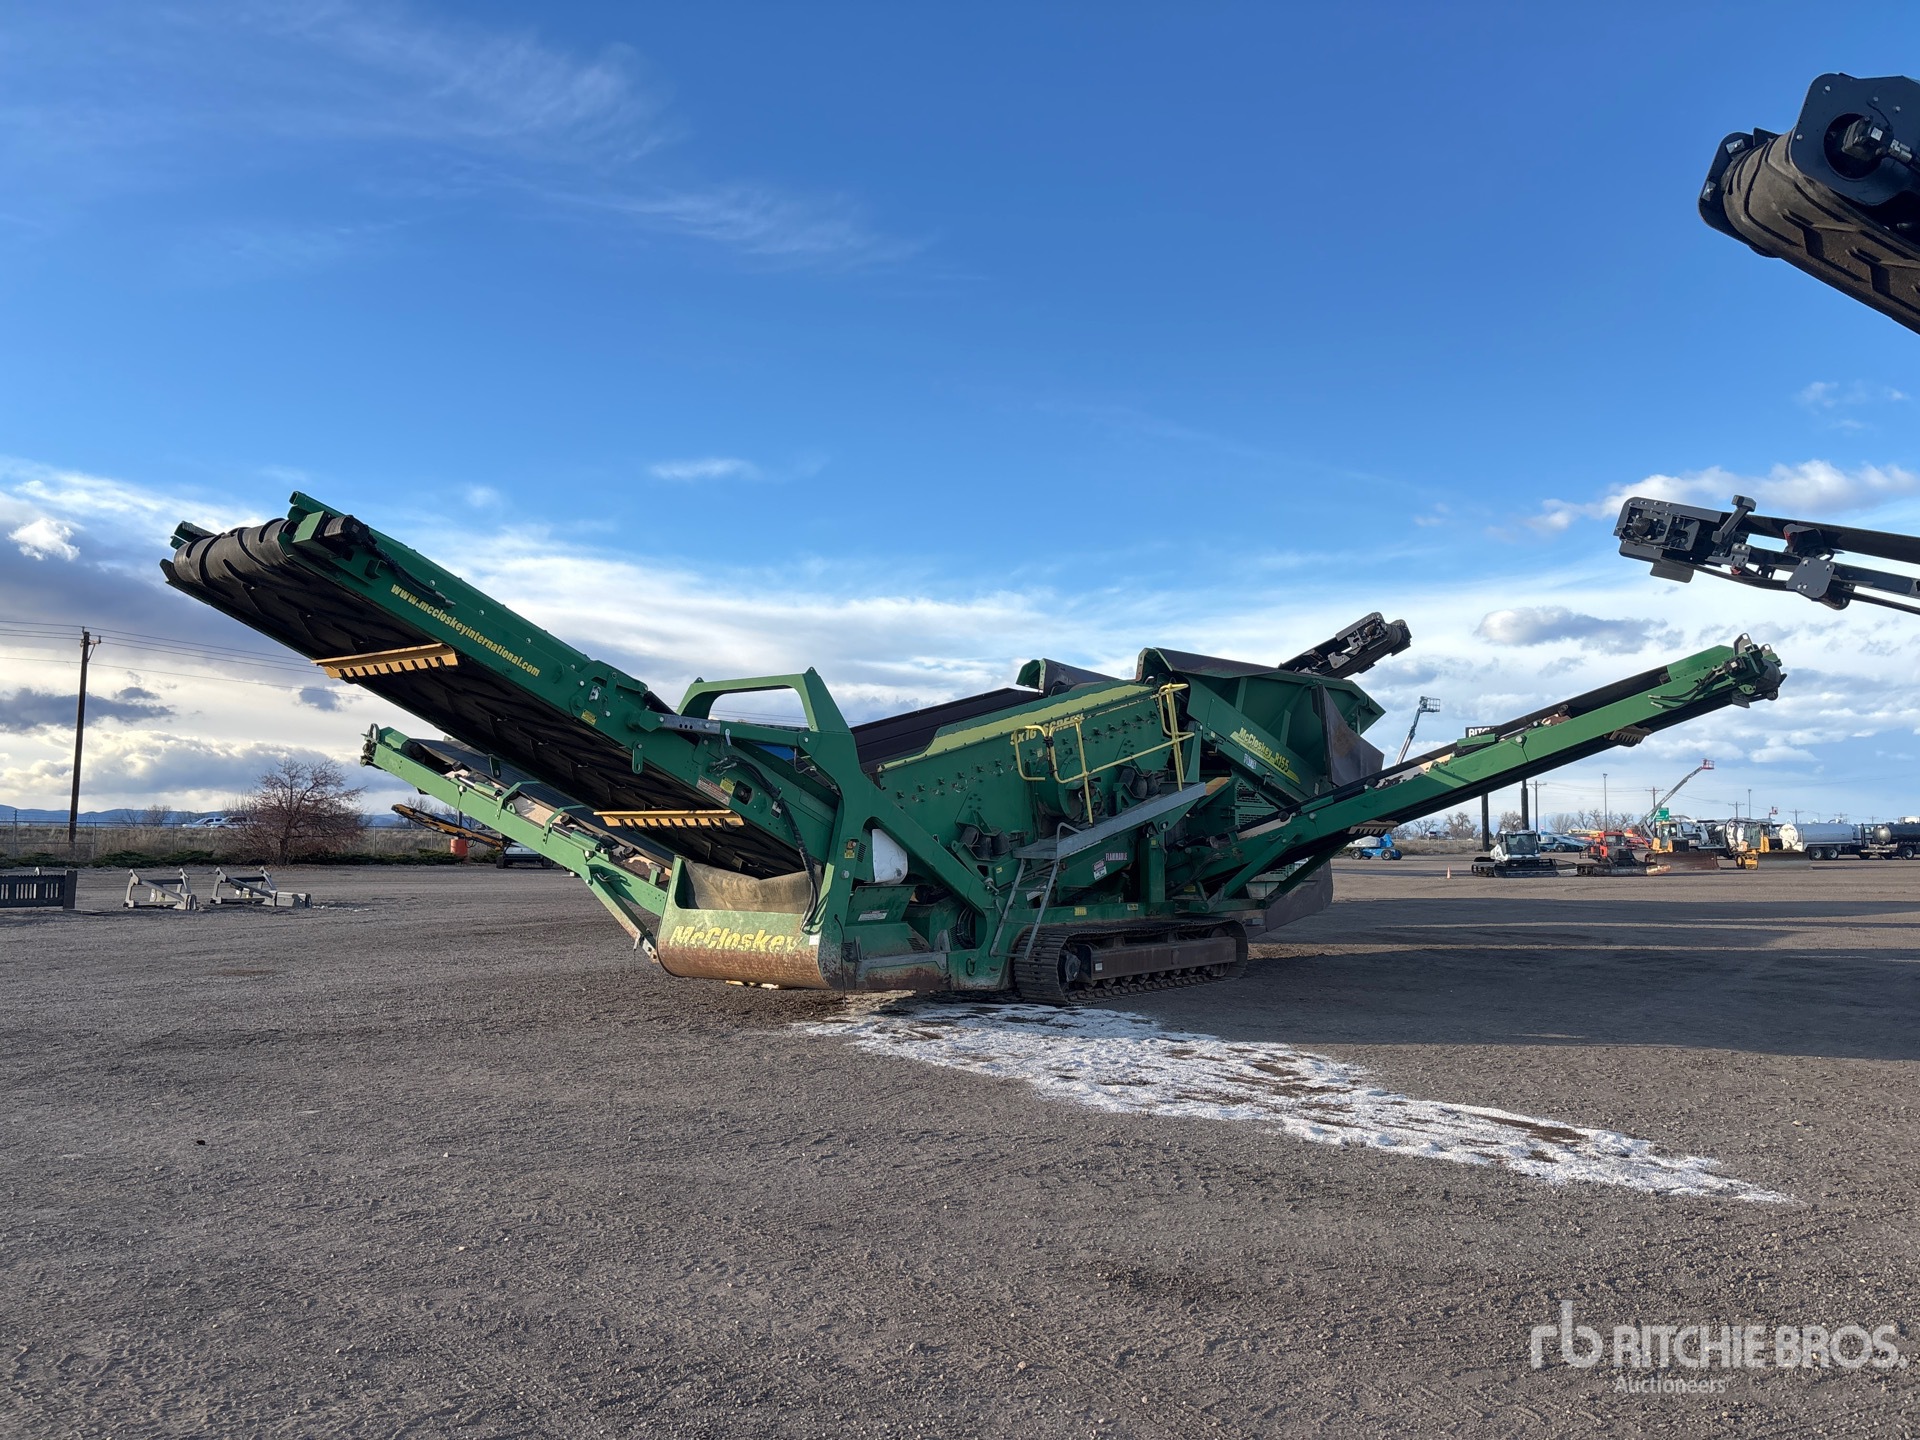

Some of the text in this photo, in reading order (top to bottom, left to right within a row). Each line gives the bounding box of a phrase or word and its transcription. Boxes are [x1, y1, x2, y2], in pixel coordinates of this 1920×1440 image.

[391, 584, 540, 677] www.mccloskeyinternational.com
[1239, 727, 1272, 759] McCloskey
[1275, 752, 1290, 773] R155
[669, 925, 803, 953] McCloskey
